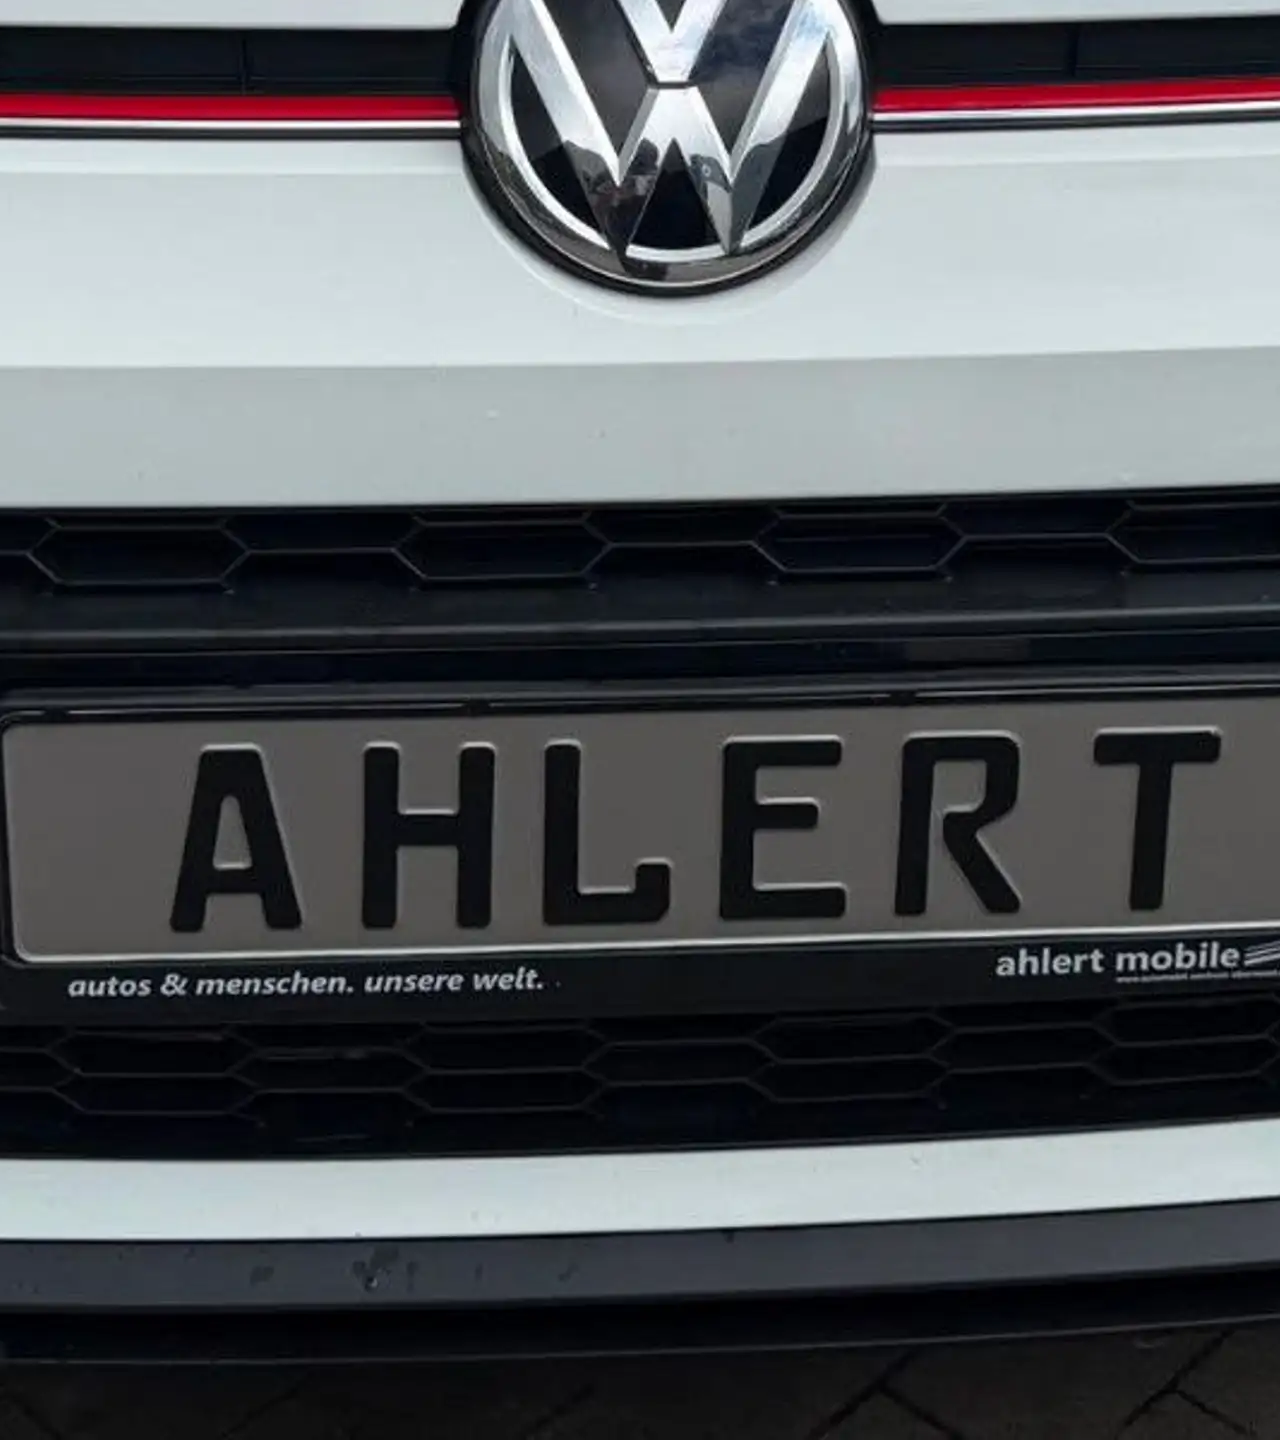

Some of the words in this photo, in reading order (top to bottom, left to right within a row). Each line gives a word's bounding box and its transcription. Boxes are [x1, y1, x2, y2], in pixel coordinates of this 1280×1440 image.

[170, 726, 1224, 932] AHLERT
[995, 946, 1105, 977] ahlert
[1115, 940, 1241, 972] mobile
[67, 974, 152, 998] autos
[160, 973, 187, 997] &
[195, 970, 355, 996] menschen.
[363, 971, 464, 993] unsere
[473, 967, 545, 991] welt.
